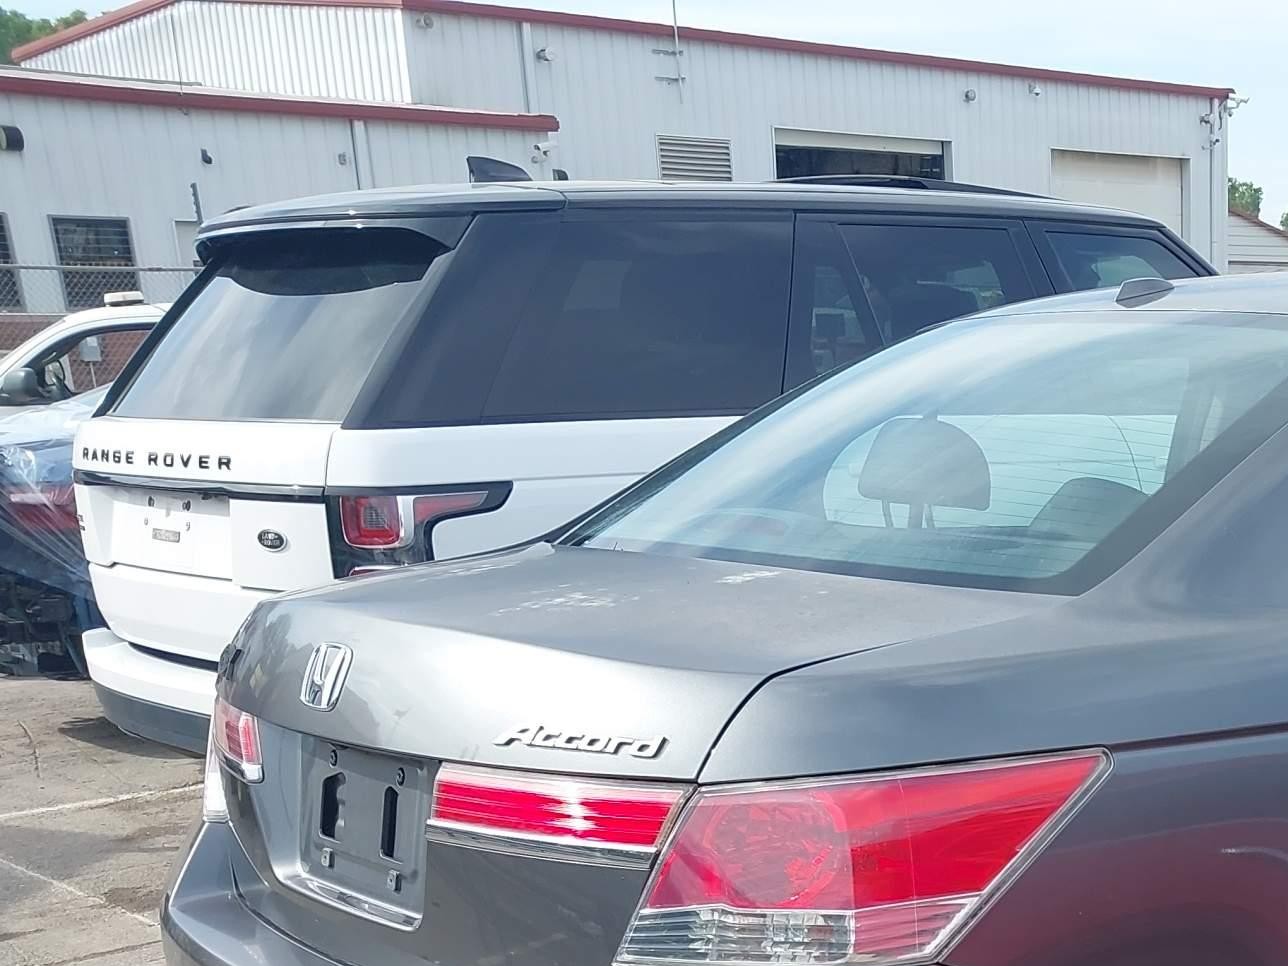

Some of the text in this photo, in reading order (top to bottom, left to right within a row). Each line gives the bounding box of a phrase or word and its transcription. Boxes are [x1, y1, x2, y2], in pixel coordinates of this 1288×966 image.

[82, 447, 231, 471] RANGE ROVER
[492, 724, 670, 760] Accord
